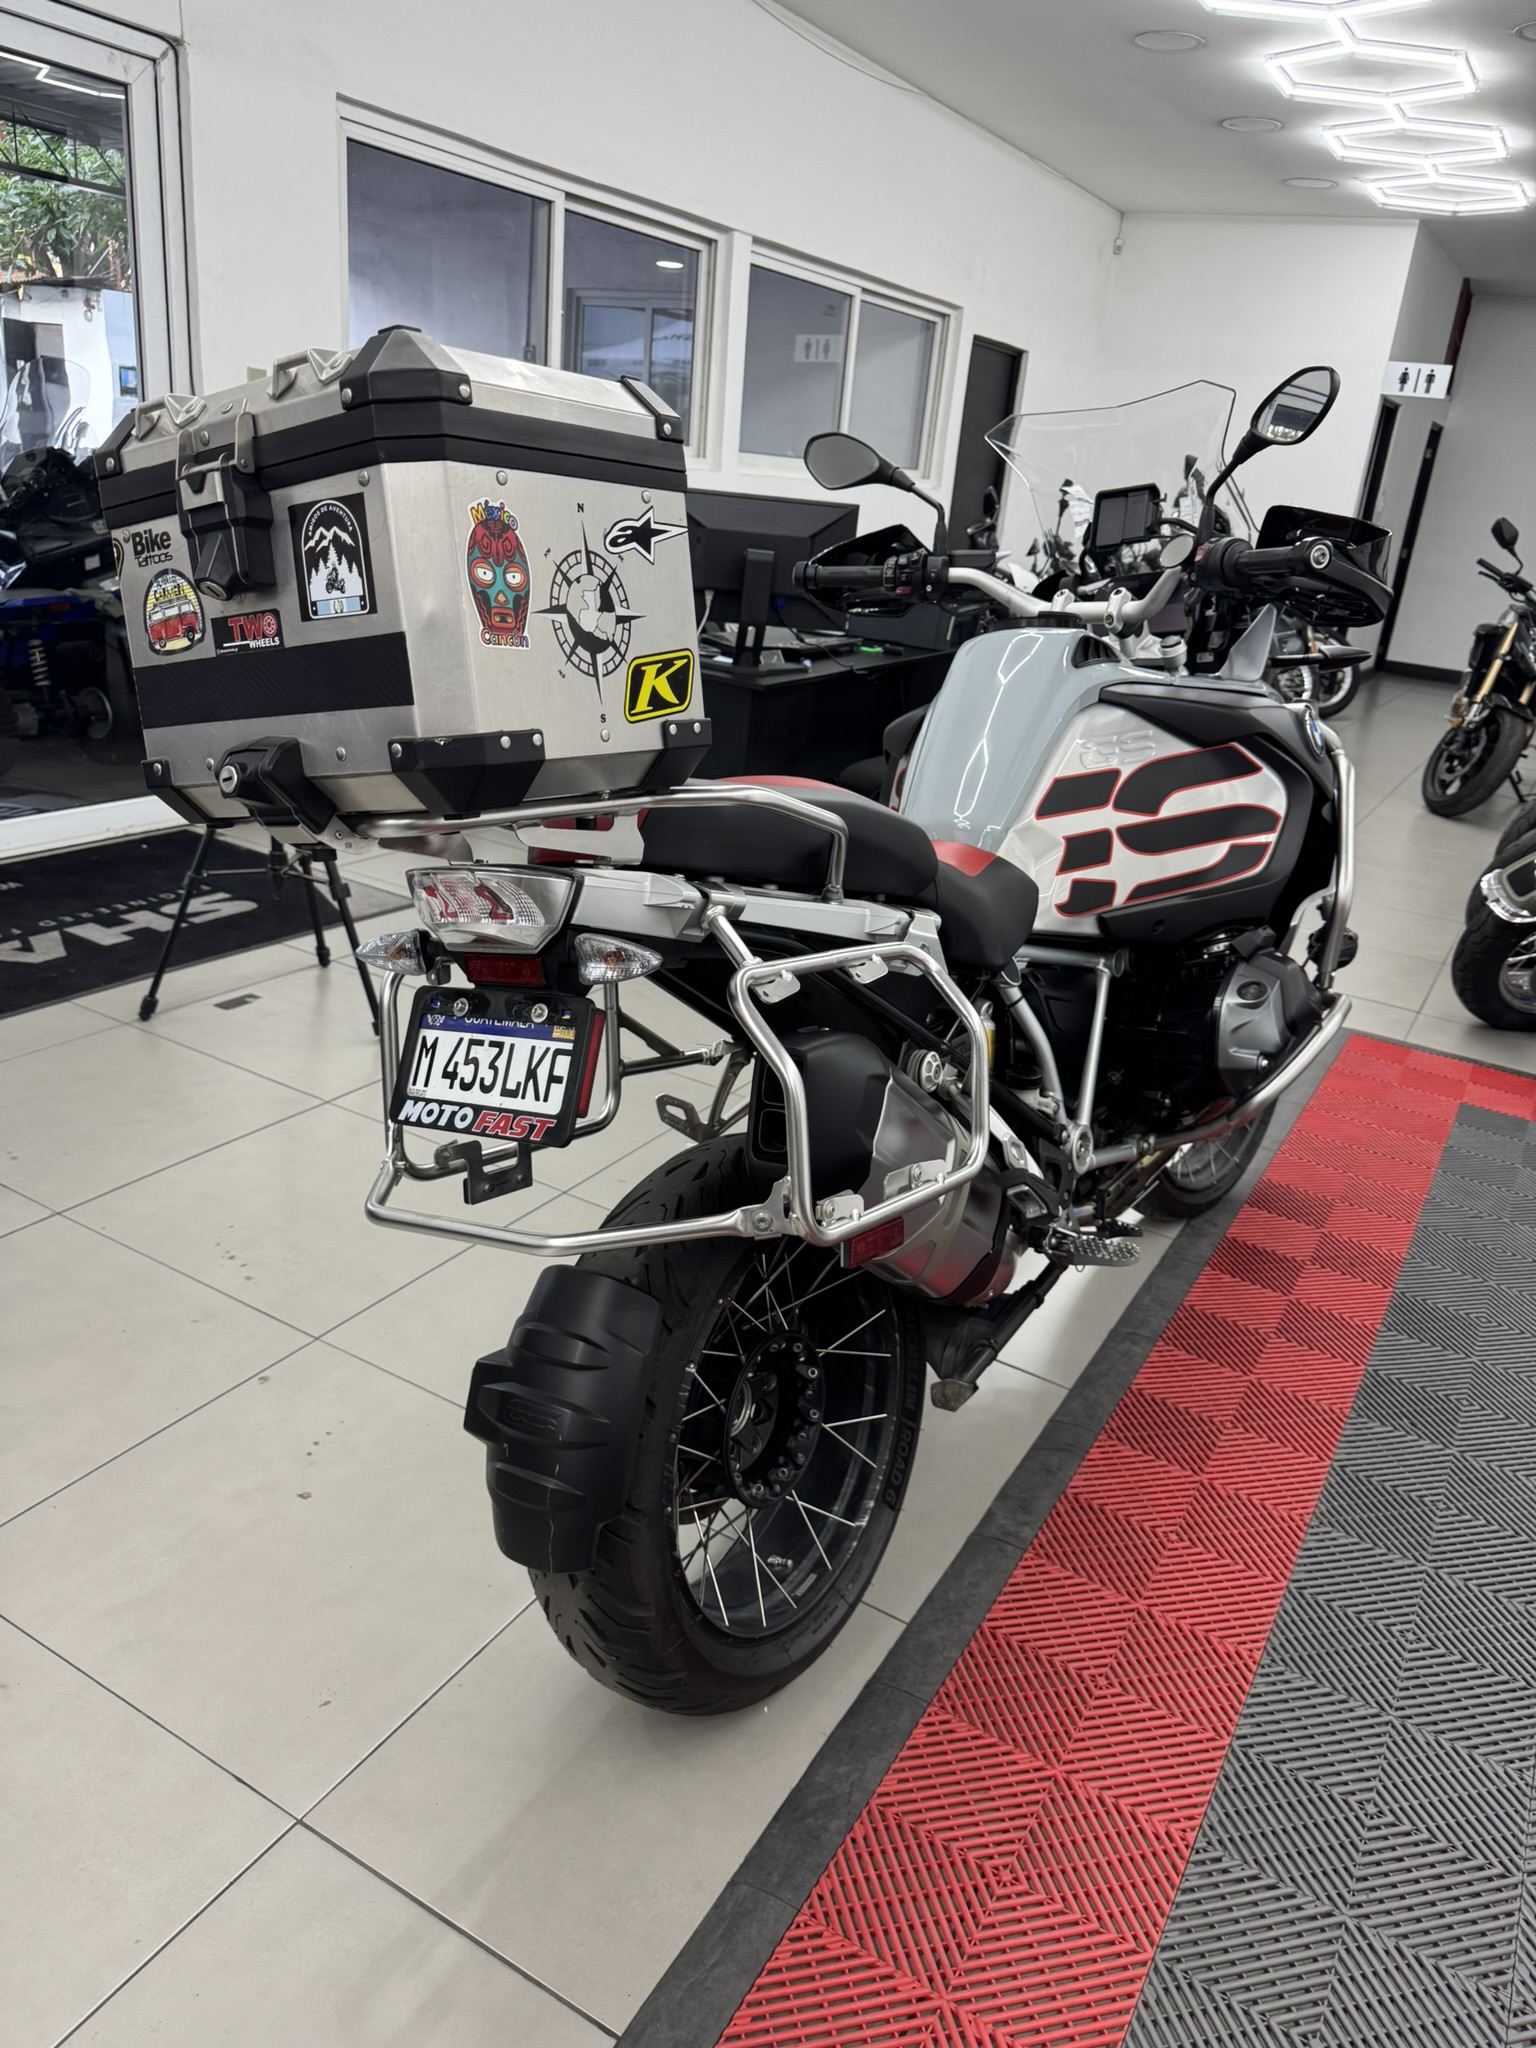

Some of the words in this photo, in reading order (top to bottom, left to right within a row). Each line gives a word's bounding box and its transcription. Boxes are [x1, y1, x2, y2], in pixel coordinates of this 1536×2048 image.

[308, 510, 321, 537] AMIGOS
[320, 505, 328, 513] DE
[329, 505, 353, 532] AVENTURA
[470, 499, 518, 531] México
[577, 503, 584, 512] N
[131, 528, 172, 557] Bike
[135, 552, 173, 568] Tattoos
[228, 612, 278, 642] TWO
[480, 628, 529, 648] Cancún
[248, 637, 280, 649] WHEELS
[630, 658, 688, 714] K
[600, 713, 607, 724] S
[411, 1035, 439, 1088] M
[441, 1036, 574, 1103] 453LKF
[397, 1100, 475, 1130] MOTO
[472, 1110, 557, 1141] FAST
[902, 1305, 919, 1411] MICHELIN
[891, 1426, 912, 1486] ROAD
[884, 1492, 897, 1506] 6
